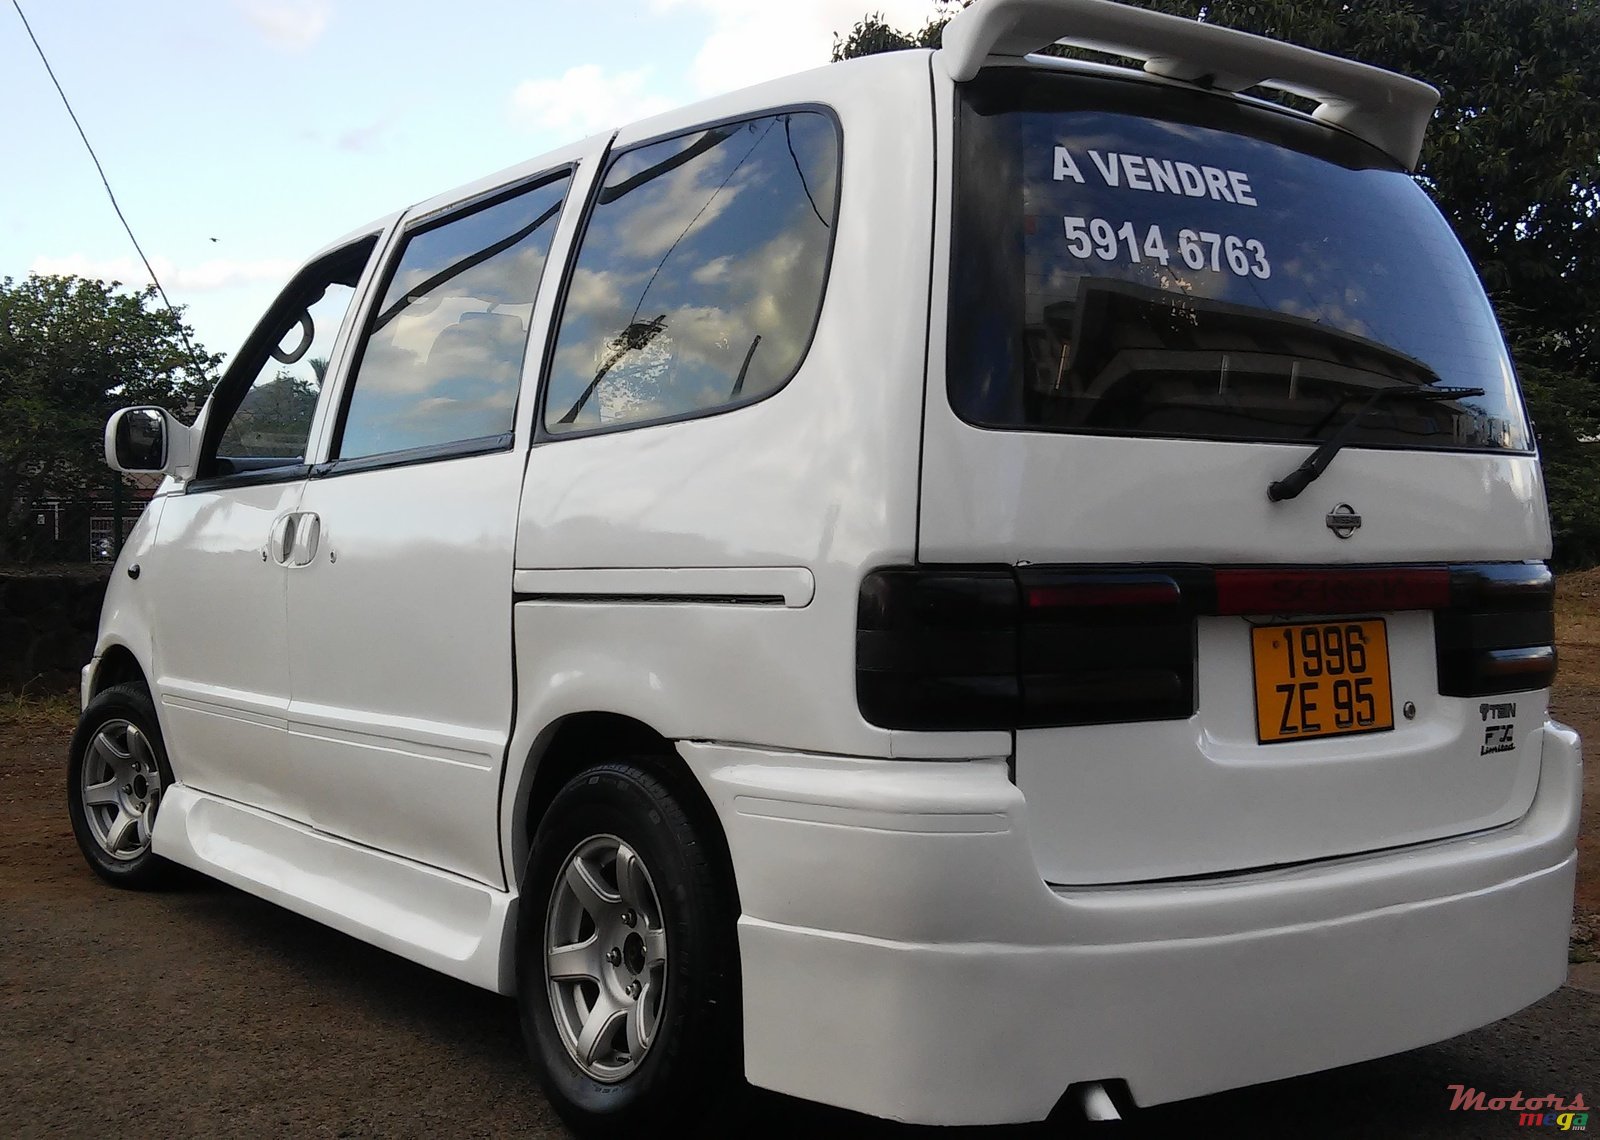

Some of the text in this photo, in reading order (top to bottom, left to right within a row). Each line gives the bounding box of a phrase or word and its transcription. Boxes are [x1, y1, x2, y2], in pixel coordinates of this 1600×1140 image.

[1053, 146, 1257, 207] A VENDRE
[1063, 216, 1271, 280] 5914 6763
[1284, 625, 1367, 678] 1996
[1276, 677, 1375, 735] ZE 95
[1480, 743, 1516, 756] Limited
